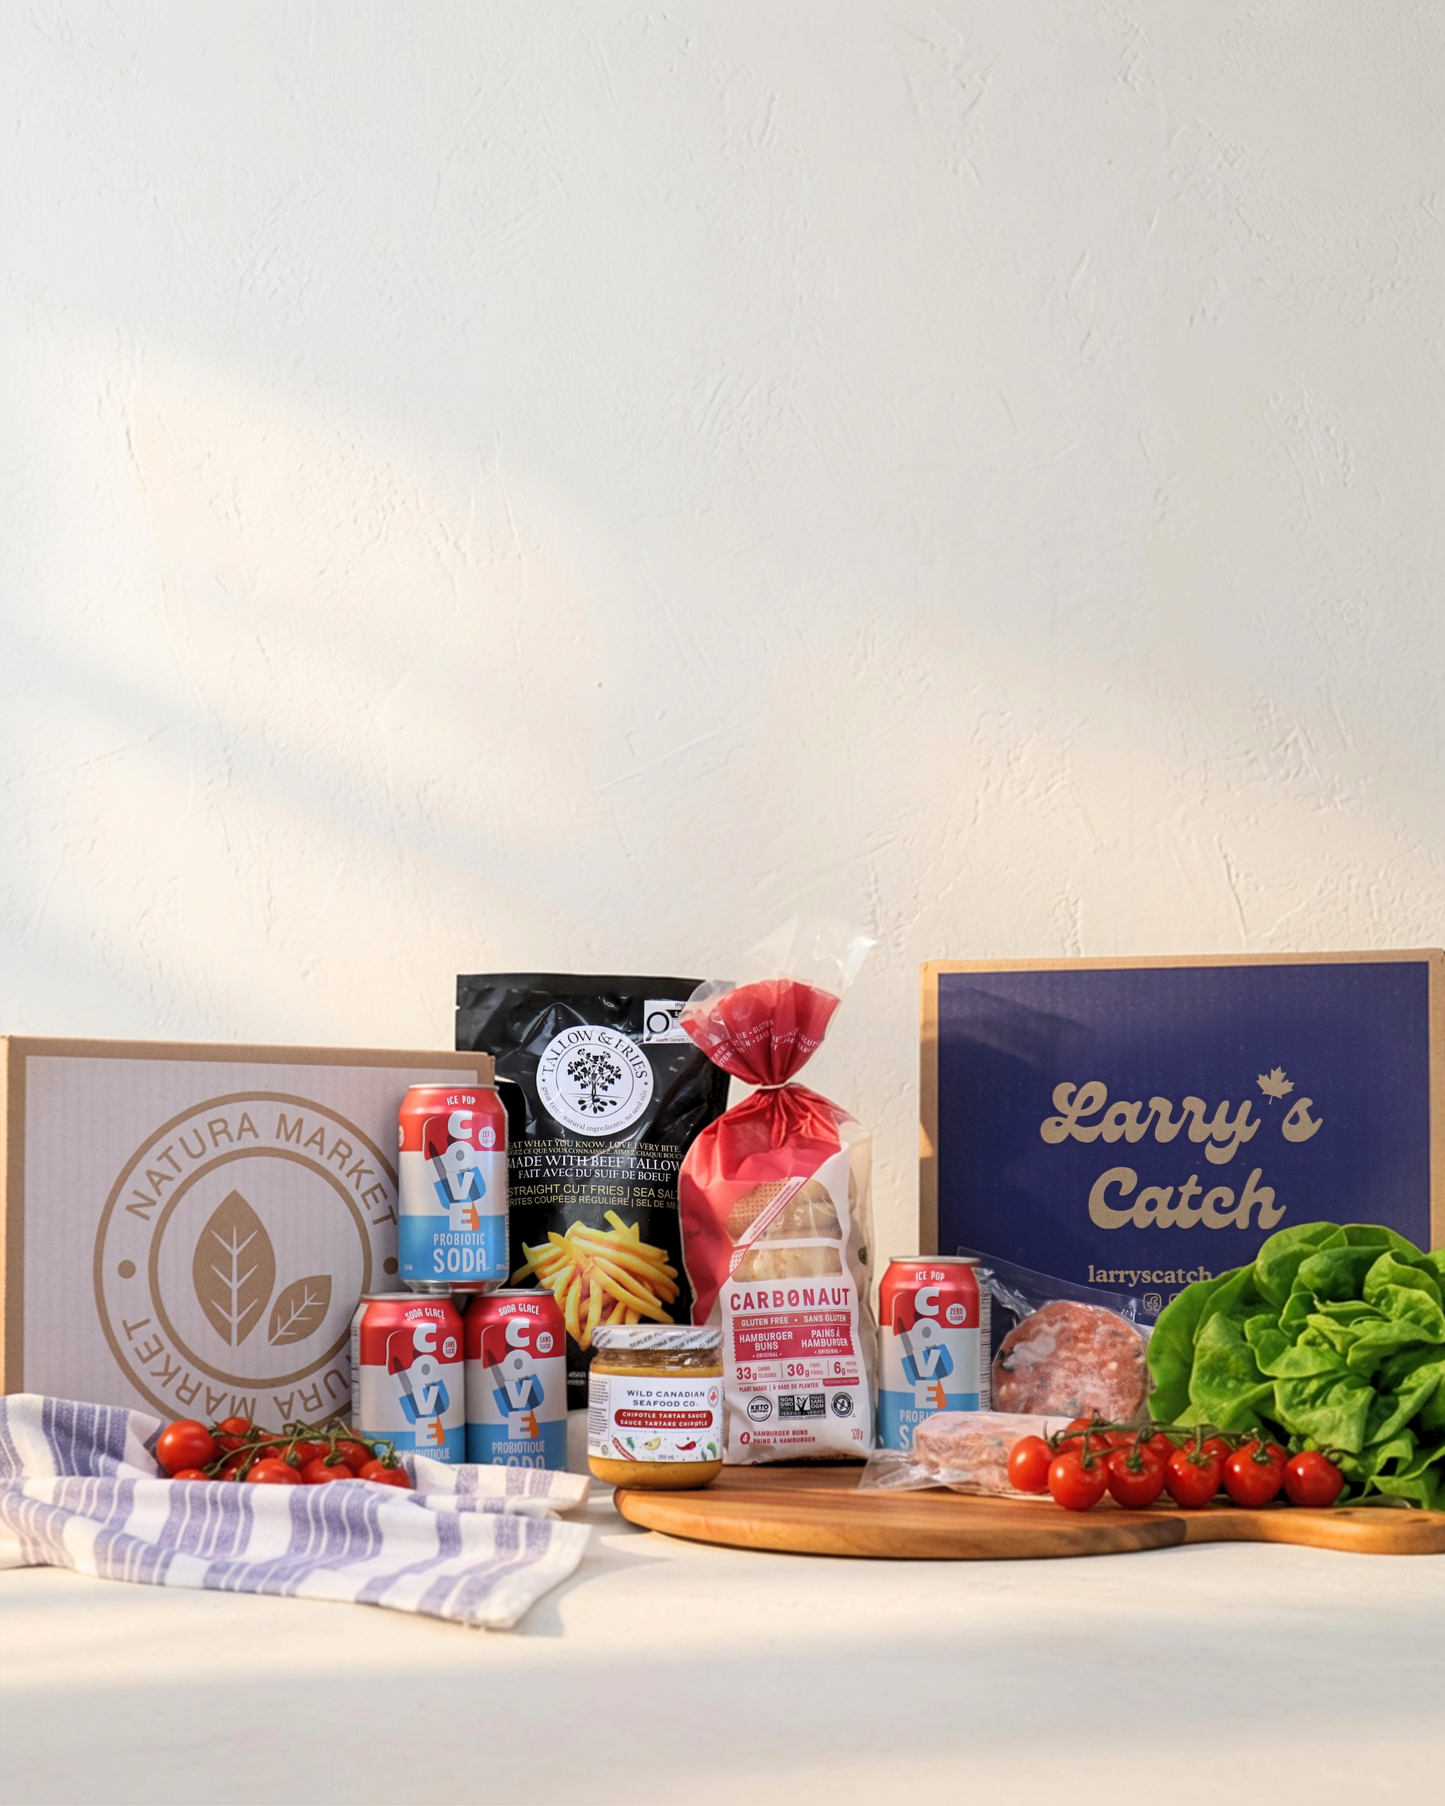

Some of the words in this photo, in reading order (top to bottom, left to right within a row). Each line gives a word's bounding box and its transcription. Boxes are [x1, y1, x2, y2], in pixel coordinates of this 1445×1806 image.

[542, 1030, 594, 1075] TALLOW
[598, 1031, 613, 1045] &
[614, 1038, 648, 1079] FRIES
[711, 1045, 726, 1063] FREE
[446, 1095, 459, 1105] ICE
[462, 1095, 476, 1105] POP
[562, 1115, 586, 1130] natural
[624, 1113, 633, 1121] no
[632, 1101, 643, 1114] seed
[1040, 1066, 1323, 1165] Larry's
[524, 1140, 554, 1148] WHAT
[554, 1140, 575, 1148] YOU
[609, 1141, 633, 1149] LOVE
[634, 1142, 660, 1151] EVERY
[126, 1113, 260, 1221] NATURA
[274, 1114, 397, 1227] MARKET
[445, 1110, 476, 1231] COVE
[508, 1156, 542, 1168] MADE
[545, 1155, 590, 1167] WITH
[591, 1156, 625, 1167] BEEF
[628, 1157, 681, 1172] TALLOW
[518, 1169, 541, 1179] FAIT
[542, 1168, 573, 1178] AVEC
[575, 1169, 591, 1177] DU
[594, 1170, 619, 1179] SUIF
[621, 1170, 636, 1179] DE
[637, 1172, 671, 1182] BOEUF
[508, 1184, 561, 1196] STRAIGHT
[563, 1184, 587, 1195] CUT
[590, 1185, 624, 1196] FRIES
[633, 1187, 655, 1198] SEA
[1088, 1166, 1287, 1230] Catch
[509, 1196, 533, 1206] RITES
[534, 1194, 577, 1205] COUPÉES
[578, 1195, 629, 1206] RÉGULIÈRE
[635, 1199, 651, 1207] SEL
[653, 1200, 665, 1208] DE
[434, 1233, 485, 1246] PROBIOTIC
[433, 1247, 487, 1273] SODA
[915, 1271, 927, 1282] ICE
[930, 1271, 945, 1282] POP
[1088, 1265, 1213, 1287] larryscatch
[405, 1308, 422, 1321] SODA
[498, 1305, 516, 1317] SODA
[949, 1307, 963, 1315] ZERO
[741, 1318, 769, 1327] GLUTEN
[770, 1316, 789, 1325] FREE
[803, 1314, 823, 1323] SANS
[825, 1314, 847, 1322] GLUTEN
[739, 1331, 793, 1343] HAMBURGER
[811, 1329, 835, 1338] PAINS
[835, 1327, 841, 1337] À
[445, 1340, 455, 1348] SANS
[629, 1334, 653, 1348] SEALED
[754, 1342, 779, 1351] BUNS
[801, 1338, 848, 1348] HAMBURGER
[912, 1286, 942, 1408] COVE
[122, 1318, 255, 1421] MARKET
[736, 1366, 757, 1381] 33g
[787, 1363, 810, 1378] 30g
[834, 1361, 846, 1376] 6g
[410, 1323, 440, 1446] COVE
[503, 1318, 534, 1439] COVE
[627, 1390, 653, 1398] WILD
[632, 1399, 680, 1407] SEAFOOD
[622, 1411, 656, 1419] CHIPOTLE
[773, 1436, 777, 1444] À
[403, 1447, 450, 1460] BIOTIQUE
[492, 1441, 546, 1454] PROBIOTIQUE
